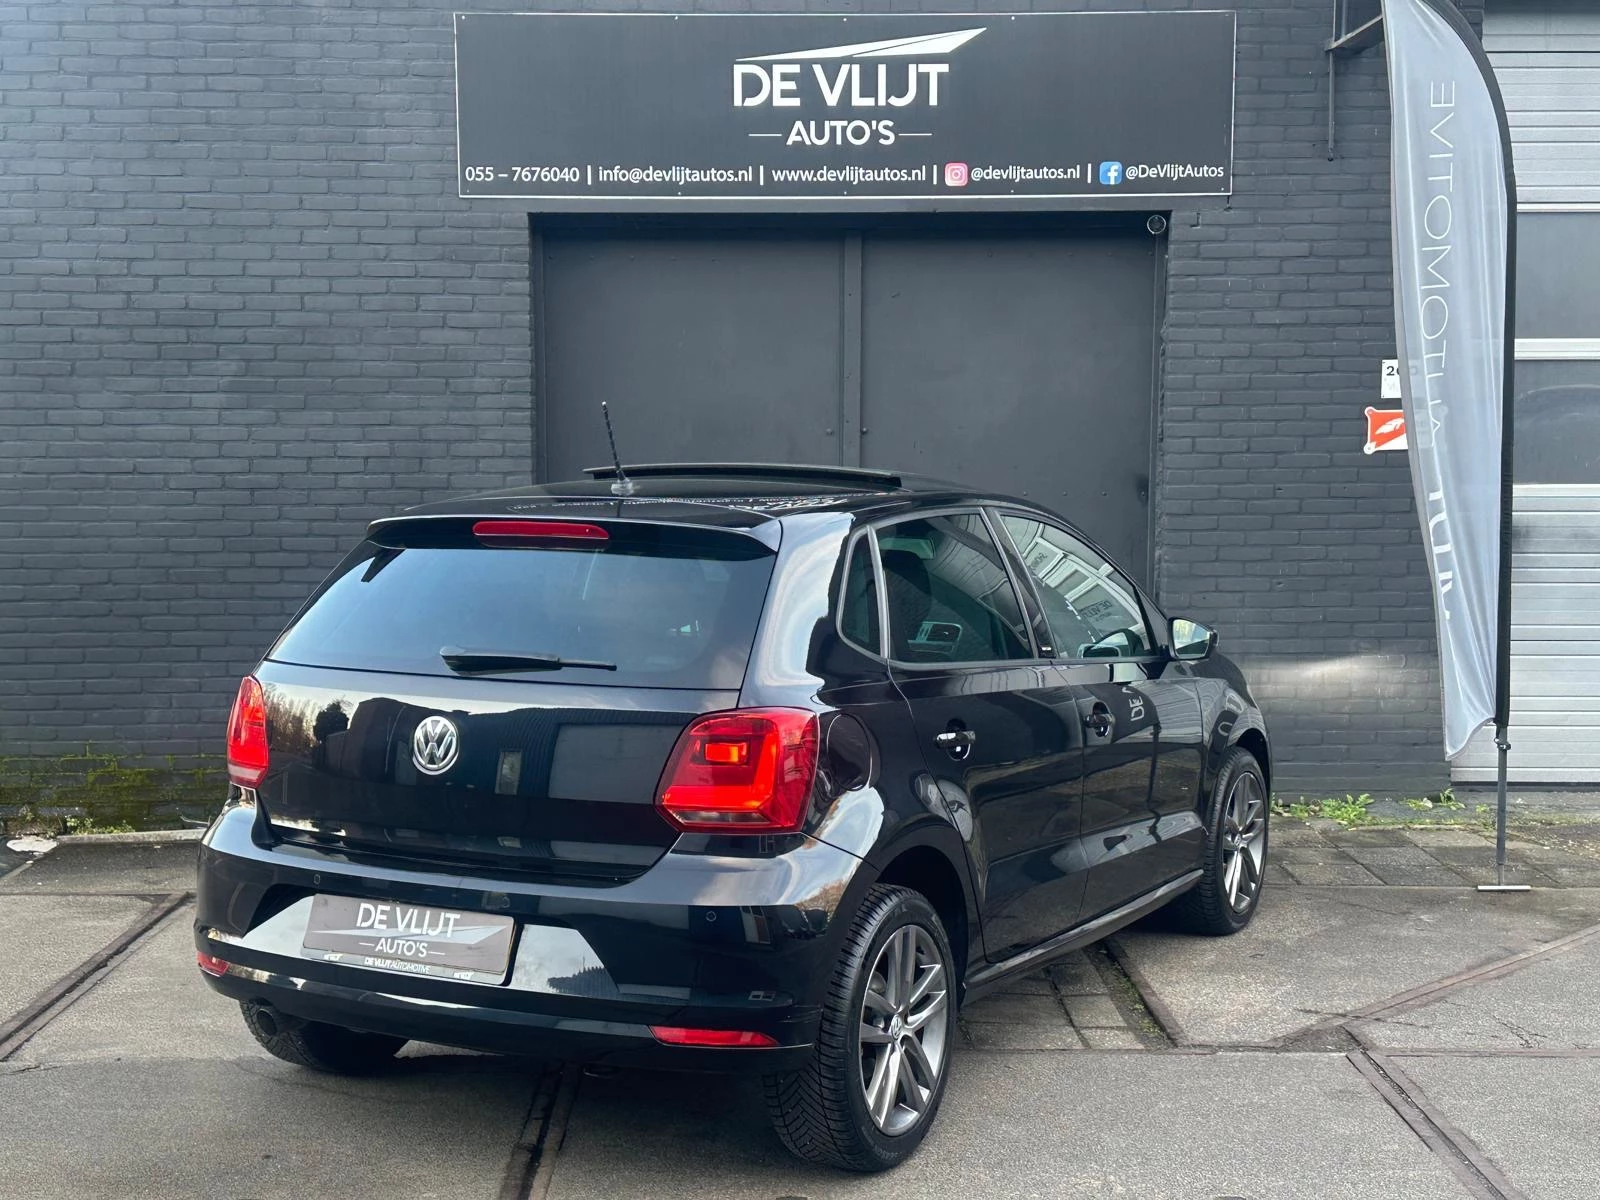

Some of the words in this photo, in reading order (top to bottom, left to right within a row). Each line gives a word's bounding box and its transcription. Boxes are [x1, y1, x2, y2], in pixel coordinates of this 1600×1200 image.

[733, 64, 800, 107] DE
[812, 63, 949, 107] VLIJT
[786, 120, 896, 146] AUTO'S
[465, 166, 494, 182] 055
[512, 166, 580, 182] 7676040
[598, 165, 752, 186] info@devlijtautos.nl
[772, 164, 926, 186] www.devlijtautos.nl
[971, 164, 1080, 183] @devlijtautos.nl
[1125, 163, 1224, 182] @DeVlijtAutos
[356, 902, 391, 929] DE
[396, 906, 460, 938] VLIJT
[375, 938, 428, 957] AUTO'S
